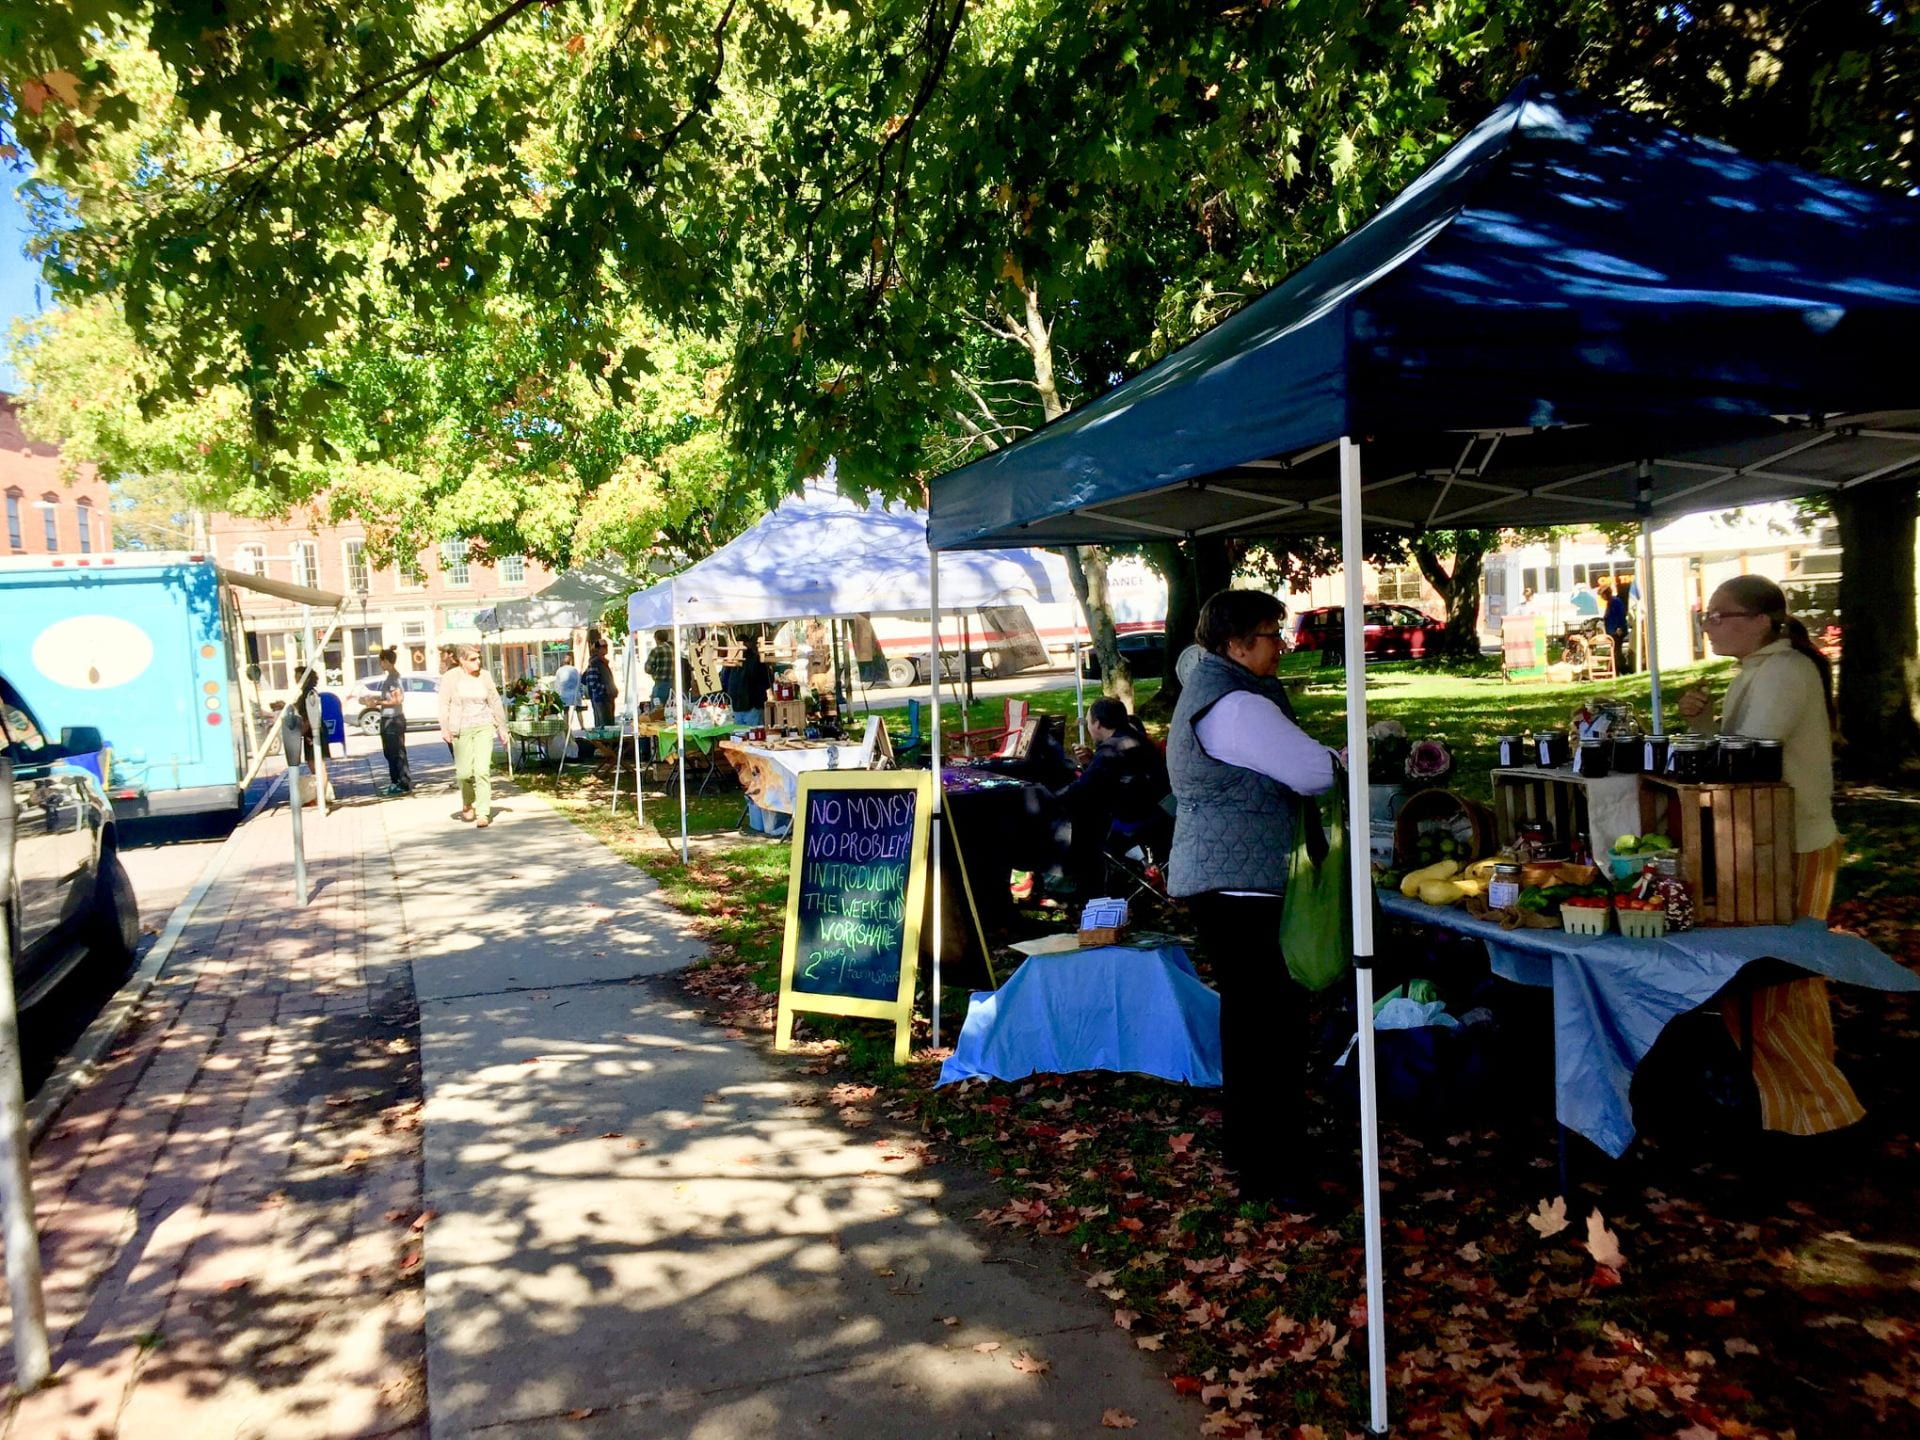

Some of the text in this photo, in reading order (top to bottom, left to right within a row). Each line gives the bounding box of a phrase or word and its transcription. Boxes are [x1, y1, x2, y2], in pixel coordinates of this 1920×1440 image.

[811, 791, 917, 831] NO MONEY?
[807, 823, 913, 863] NO PROBLEM!
[808, 862, 906, 900] INTRODUCING
[804, 892, 907, 926] THE WEEKEND
[820, 917, 897, 955] WORKSHARE
[804, 950, 822, 981] 2
[823, 946, 846, 960] hours
